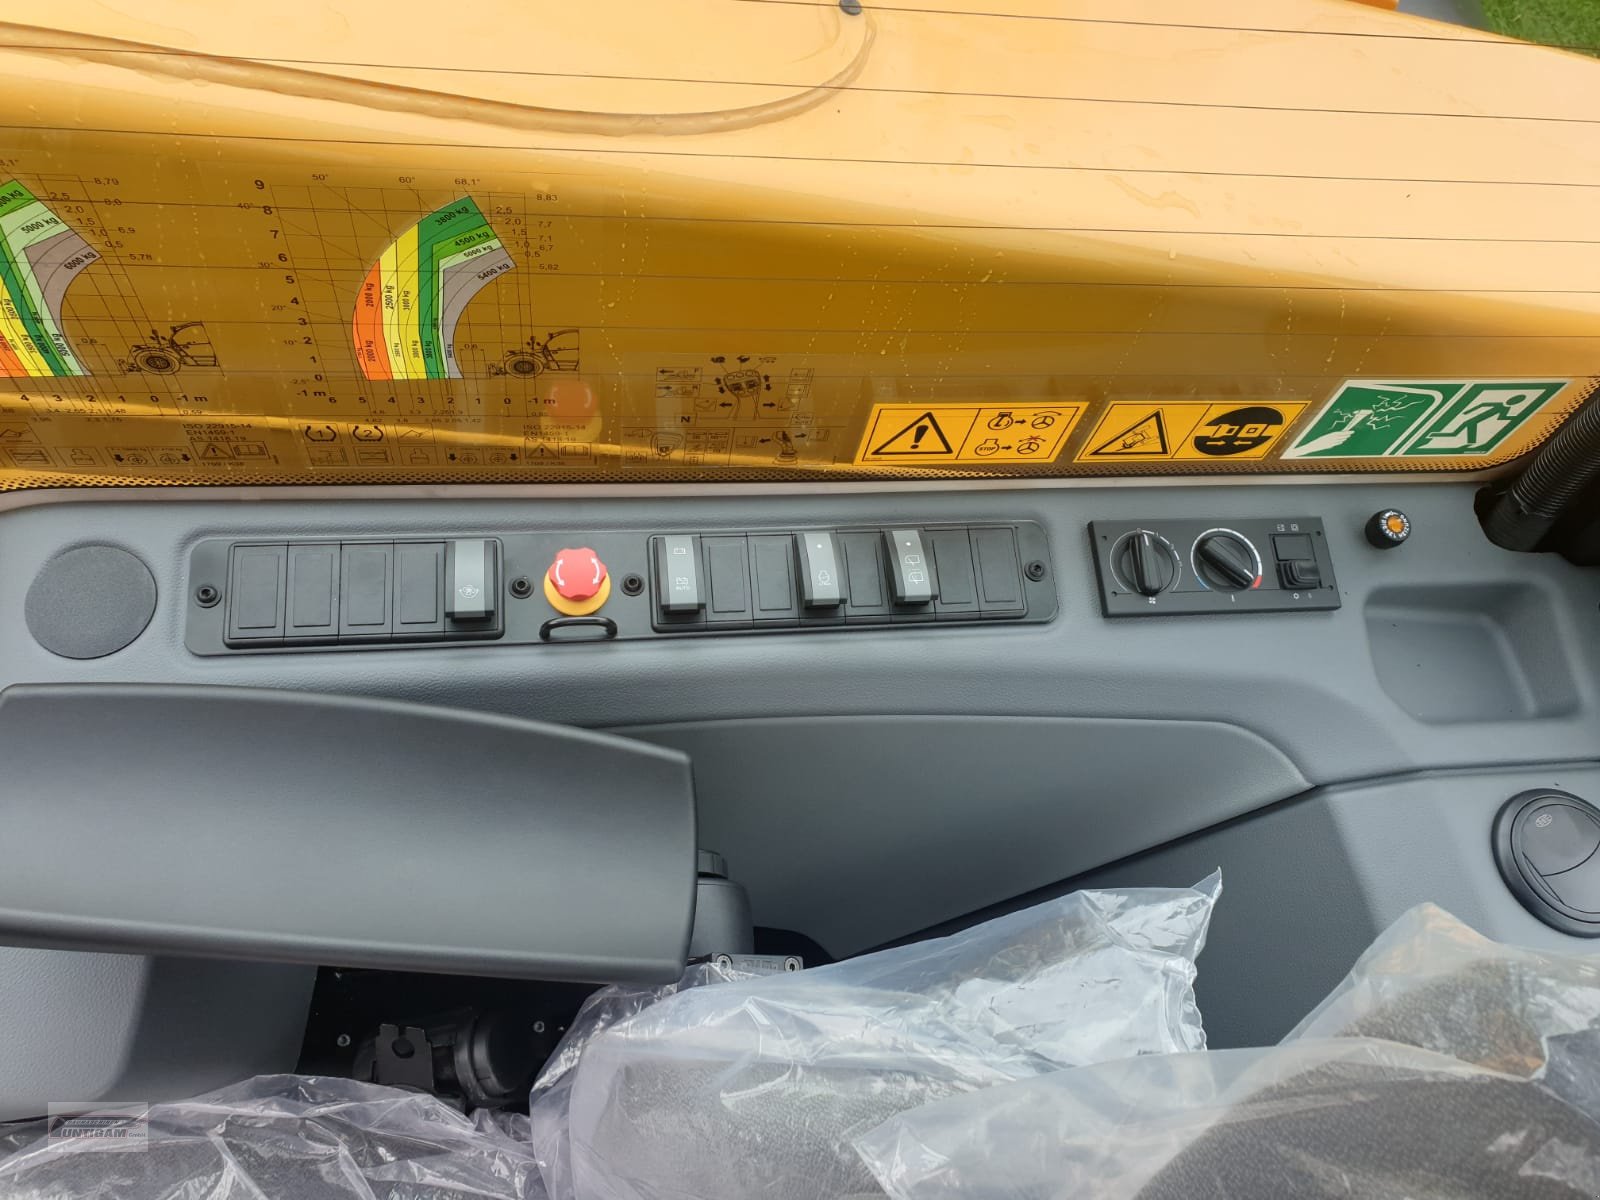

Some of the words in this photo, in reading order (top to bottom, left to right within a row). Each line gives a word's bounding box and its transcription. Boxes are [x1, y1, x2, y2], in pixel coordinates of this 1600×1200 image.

[398, 175, 416, 184] 60°
[254, 179, 265, 190] 9
[64, 205, 85, 214] 2,0
[263, 205, 273, 215] 8
[456, 205, 470, 217] kg
[21, 221, 45, 235] 5000
[44, 216, 61, 227] kg
[270, 229, 279, 239] 7
[476, 230, 491, 241] kg
[82, 250, 98, 263] kg
[277, 253, 288, 263] 6
[498, 262, 511, 274] kg
[285, 275, 296, 285] 5
[290, 296, 300, 306] 4
[297, 317, 308, 326] 3
[303, 336, 312, 345] 2
[309, 355, 318, 364] 1
[314, 374, 324, 383] 0
[296, 388, 308, 397] -1
[20, 394, 30, 402] 4
[85, 394, 97, 402] 2
[149, 394, 160, 403] 0
[176, 394, 189, 402] -1
[328, 396, 337, 404] 6
[358, 396, 367, 404] 5
[387, 396, 396, 404] 4
[417, 396, 425, 404] 3
[446, 397, 455, 405] 2
[475, 397, 481, 405] 1
[503, 397, 511, 405] 0
[680, 414, 692, 424] N
[315, 429, 323, 438] 1
[363, 429, 373, 438] 2
